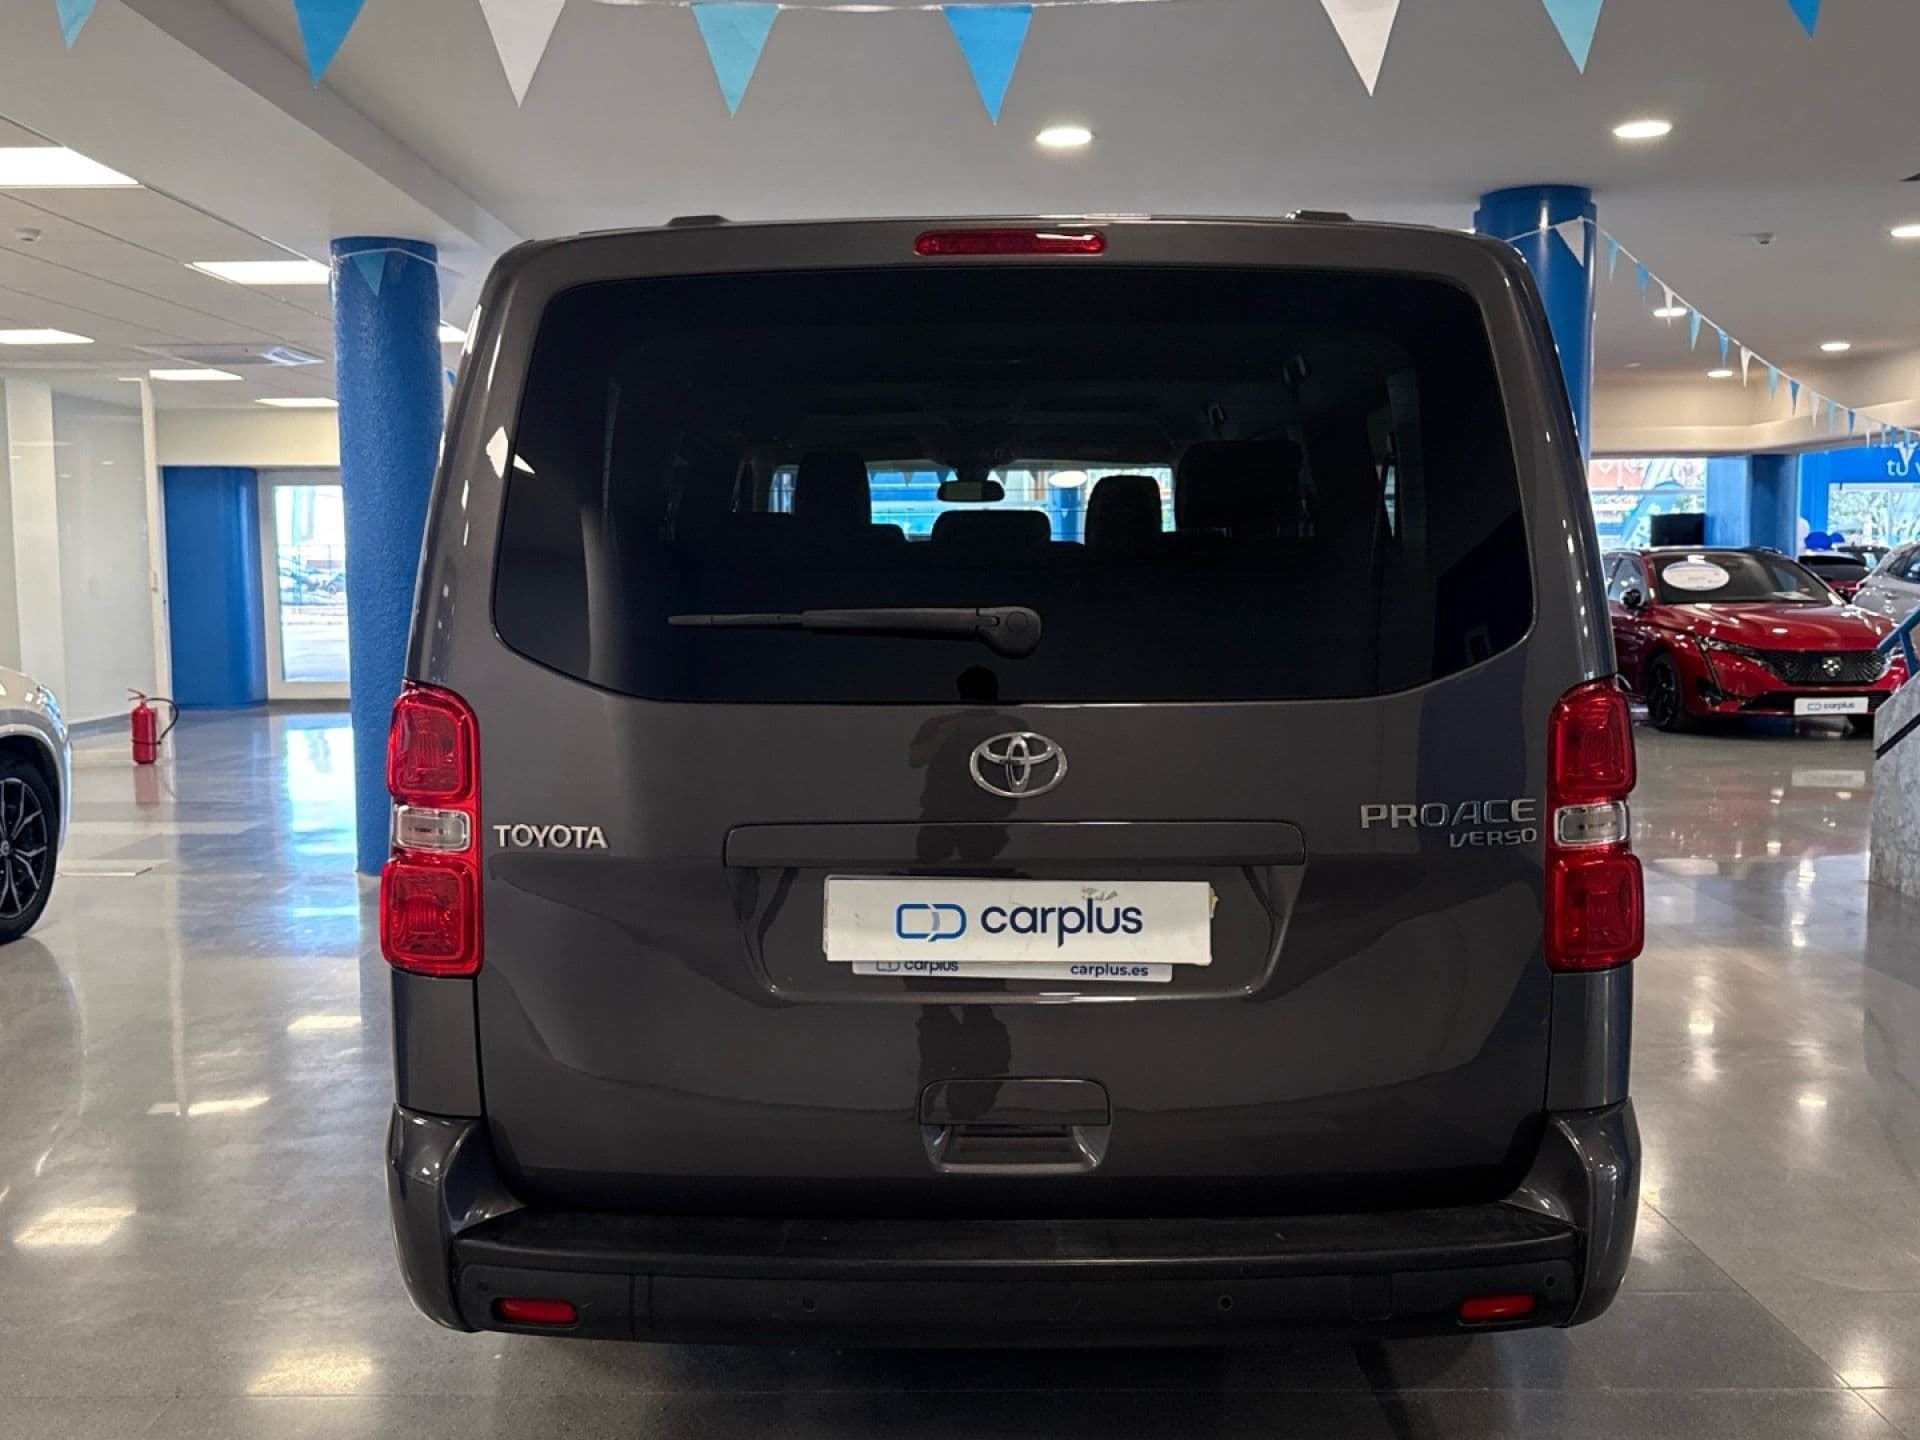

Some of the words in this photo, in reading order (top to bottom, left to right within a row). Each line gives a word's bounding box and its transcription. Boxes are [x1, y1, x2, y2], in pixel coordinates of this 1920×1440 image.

[1887, 459, 1909, 477] tu
[1360, 798, 1537, 830] PROACE
[493, 823, 609, 849] TOYOTA
[1450, 828, 1537, 849] VERSO
[980, 897, 1144, 949] carplus
[1070, 962, 1149, 978] carplus.es
